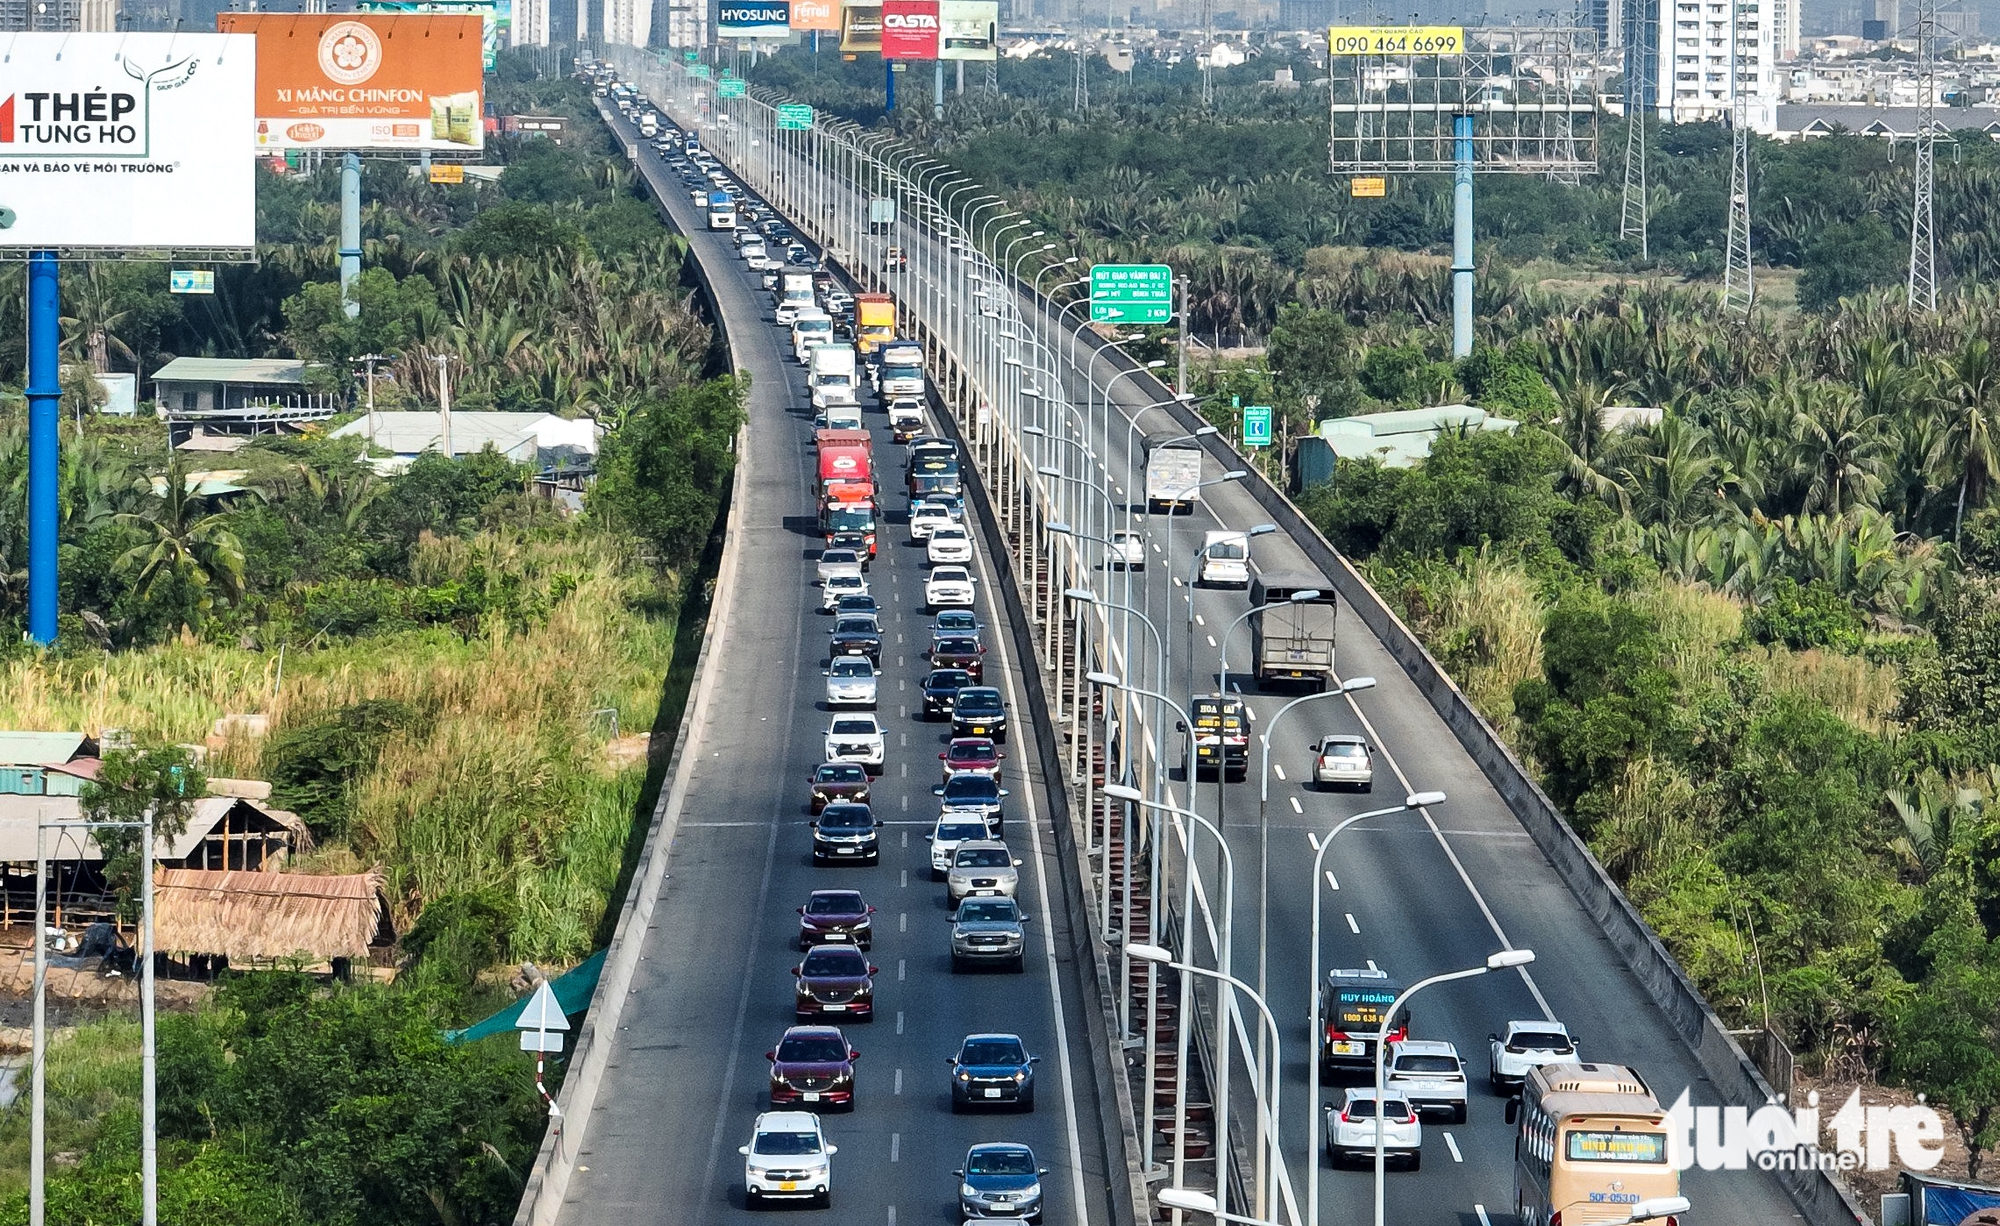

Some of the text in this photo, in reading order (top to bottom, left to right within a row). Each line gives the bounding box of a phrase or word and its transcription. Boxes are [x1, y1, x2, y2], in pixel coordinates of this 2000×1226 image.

[721, 9, 786, 21] HYOSUNG
[884, 14, 938, 28] CASTA
[1336, 36, 1456, 52] 090 464 6699
[276, 85, 423, 103] XI MĂNG CHINFON
[24, 86, 135, 122] THÉP
[20, 124, 136, 143] TUNG HO
[371, 125, 391, 135] ISO
[0, 163, 20, 175] ẠN
[23, 161, 40, 173] VÀ
[93, 161, 117, 173] MÔI
[1111, 271, 1128, 280] GIAO
[1162, 271, 1167, 280] 2
[1147, 309, 1167, 317] 2 KM
[1200, 704, 1217, 713] HOA
[1340, 993, 1361, 1002] HUY
[1343, 1013, 1361, 1022] 1900
